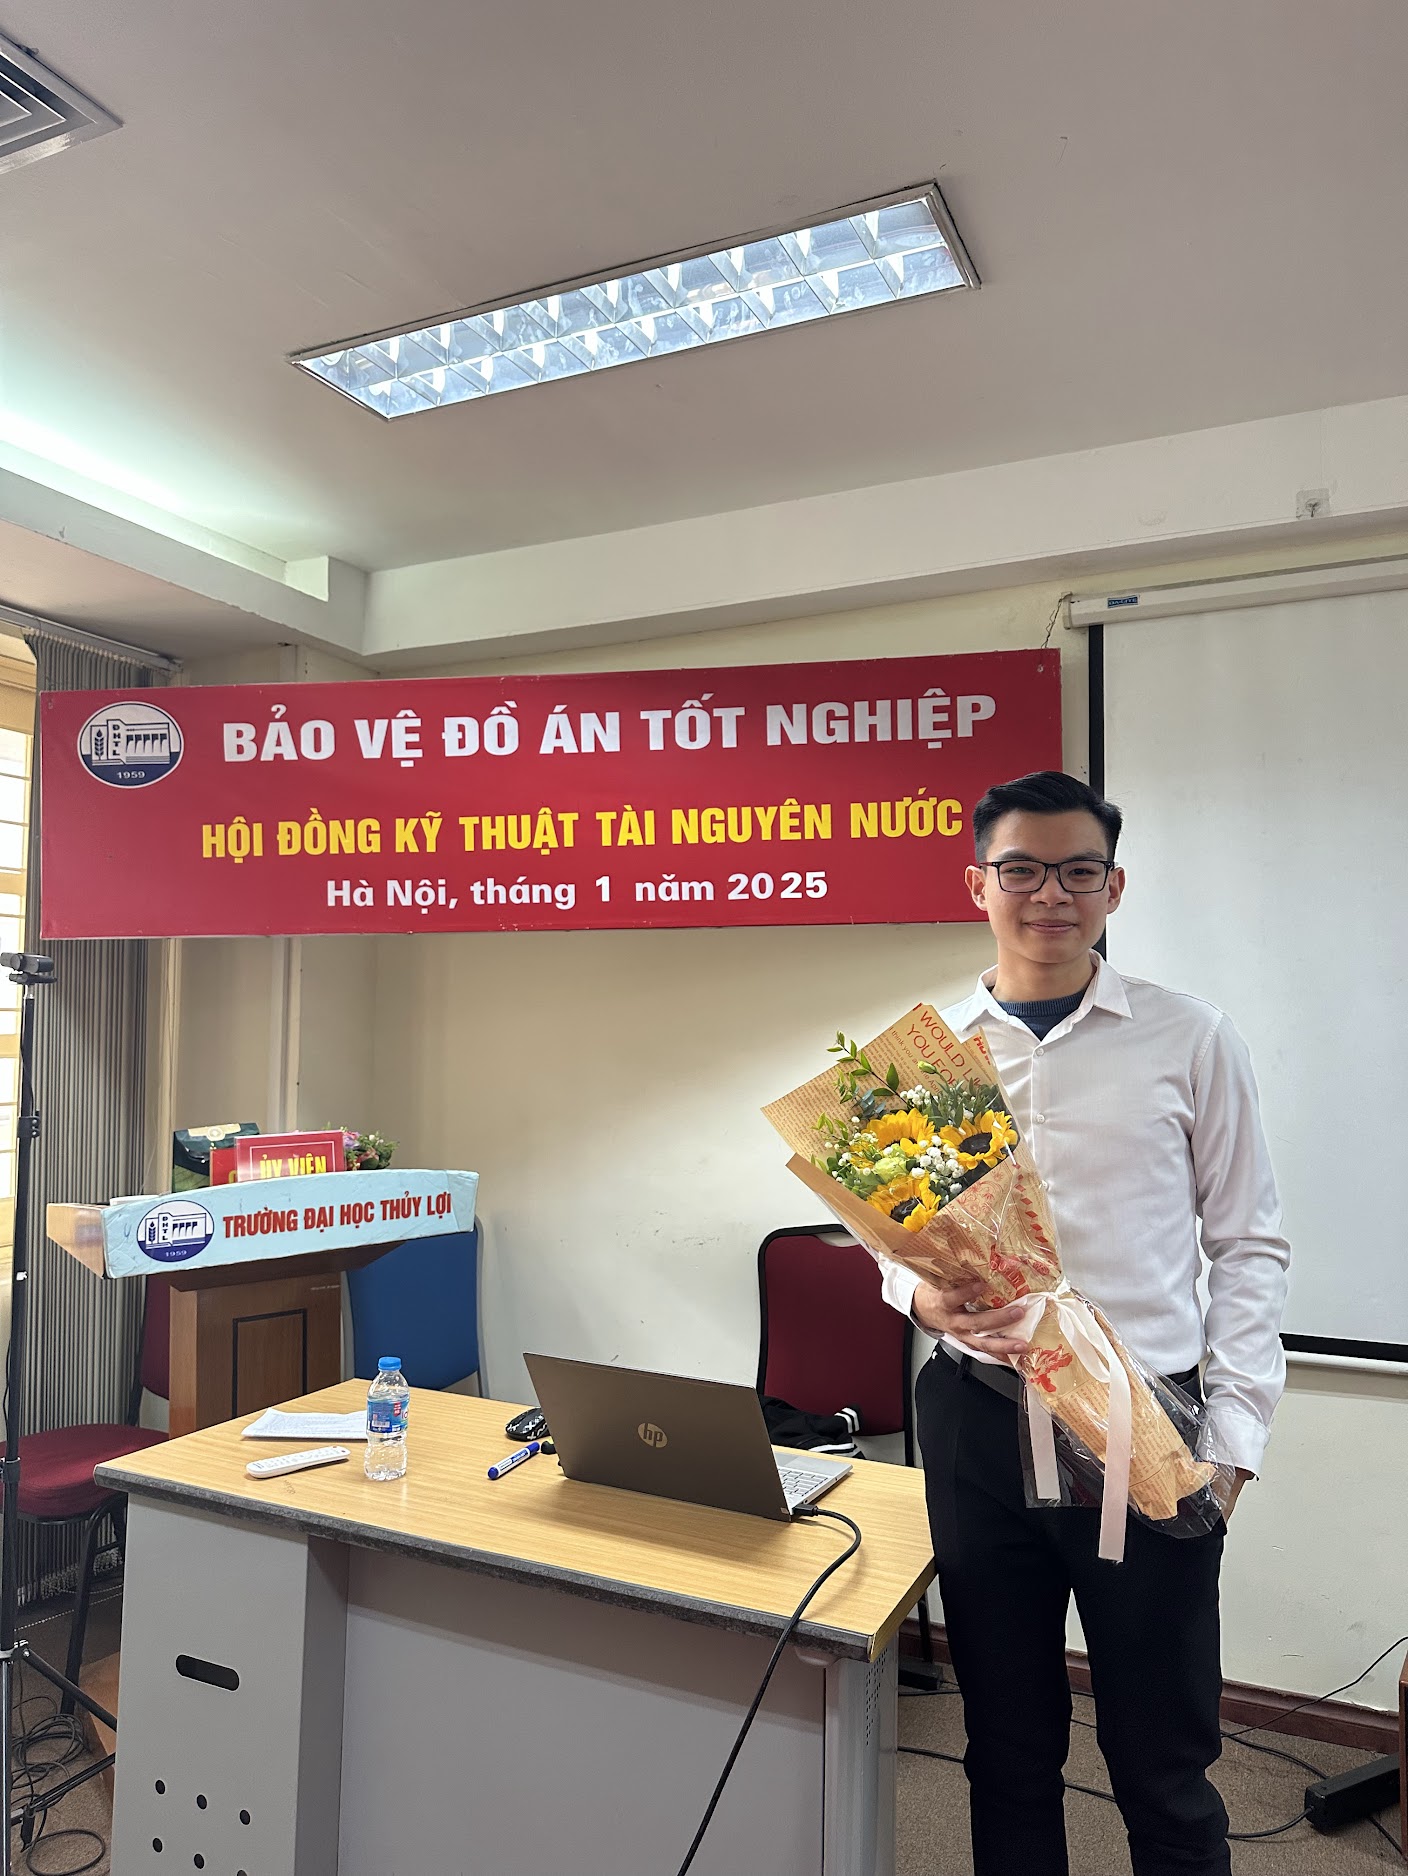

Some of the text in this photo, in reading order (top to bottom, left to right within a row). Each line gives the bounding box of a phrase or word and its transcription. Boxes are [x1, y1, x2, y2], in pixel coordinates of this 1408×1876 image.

[223, 688, 996, 768] BẢO VỆ ĐỒ ÁN TỐT NGHIỆP
[117, 771, 146, 779] 1959
[202, 787, 963, 864] HỘI ĐỒNG KỸ THUẬT TÀI NGUYÊN NƯỚC
[327, 871, 828, 915] Hà Nội, tháng 1 năm 2025
[891, 1030, 905, 1046] think
[902, 1046, 914, 1059] you
[907, 1023, 936, 1059] YOU
[919, 1010, 966, 1068] WOULD
[287, 1153, 327, 1178] VIÊN
[223, 1190, 452, 1238] TRƯỜNG ĐẠI HỌC THỦY LỢI
[642, 1423, 663, 1446] hp
